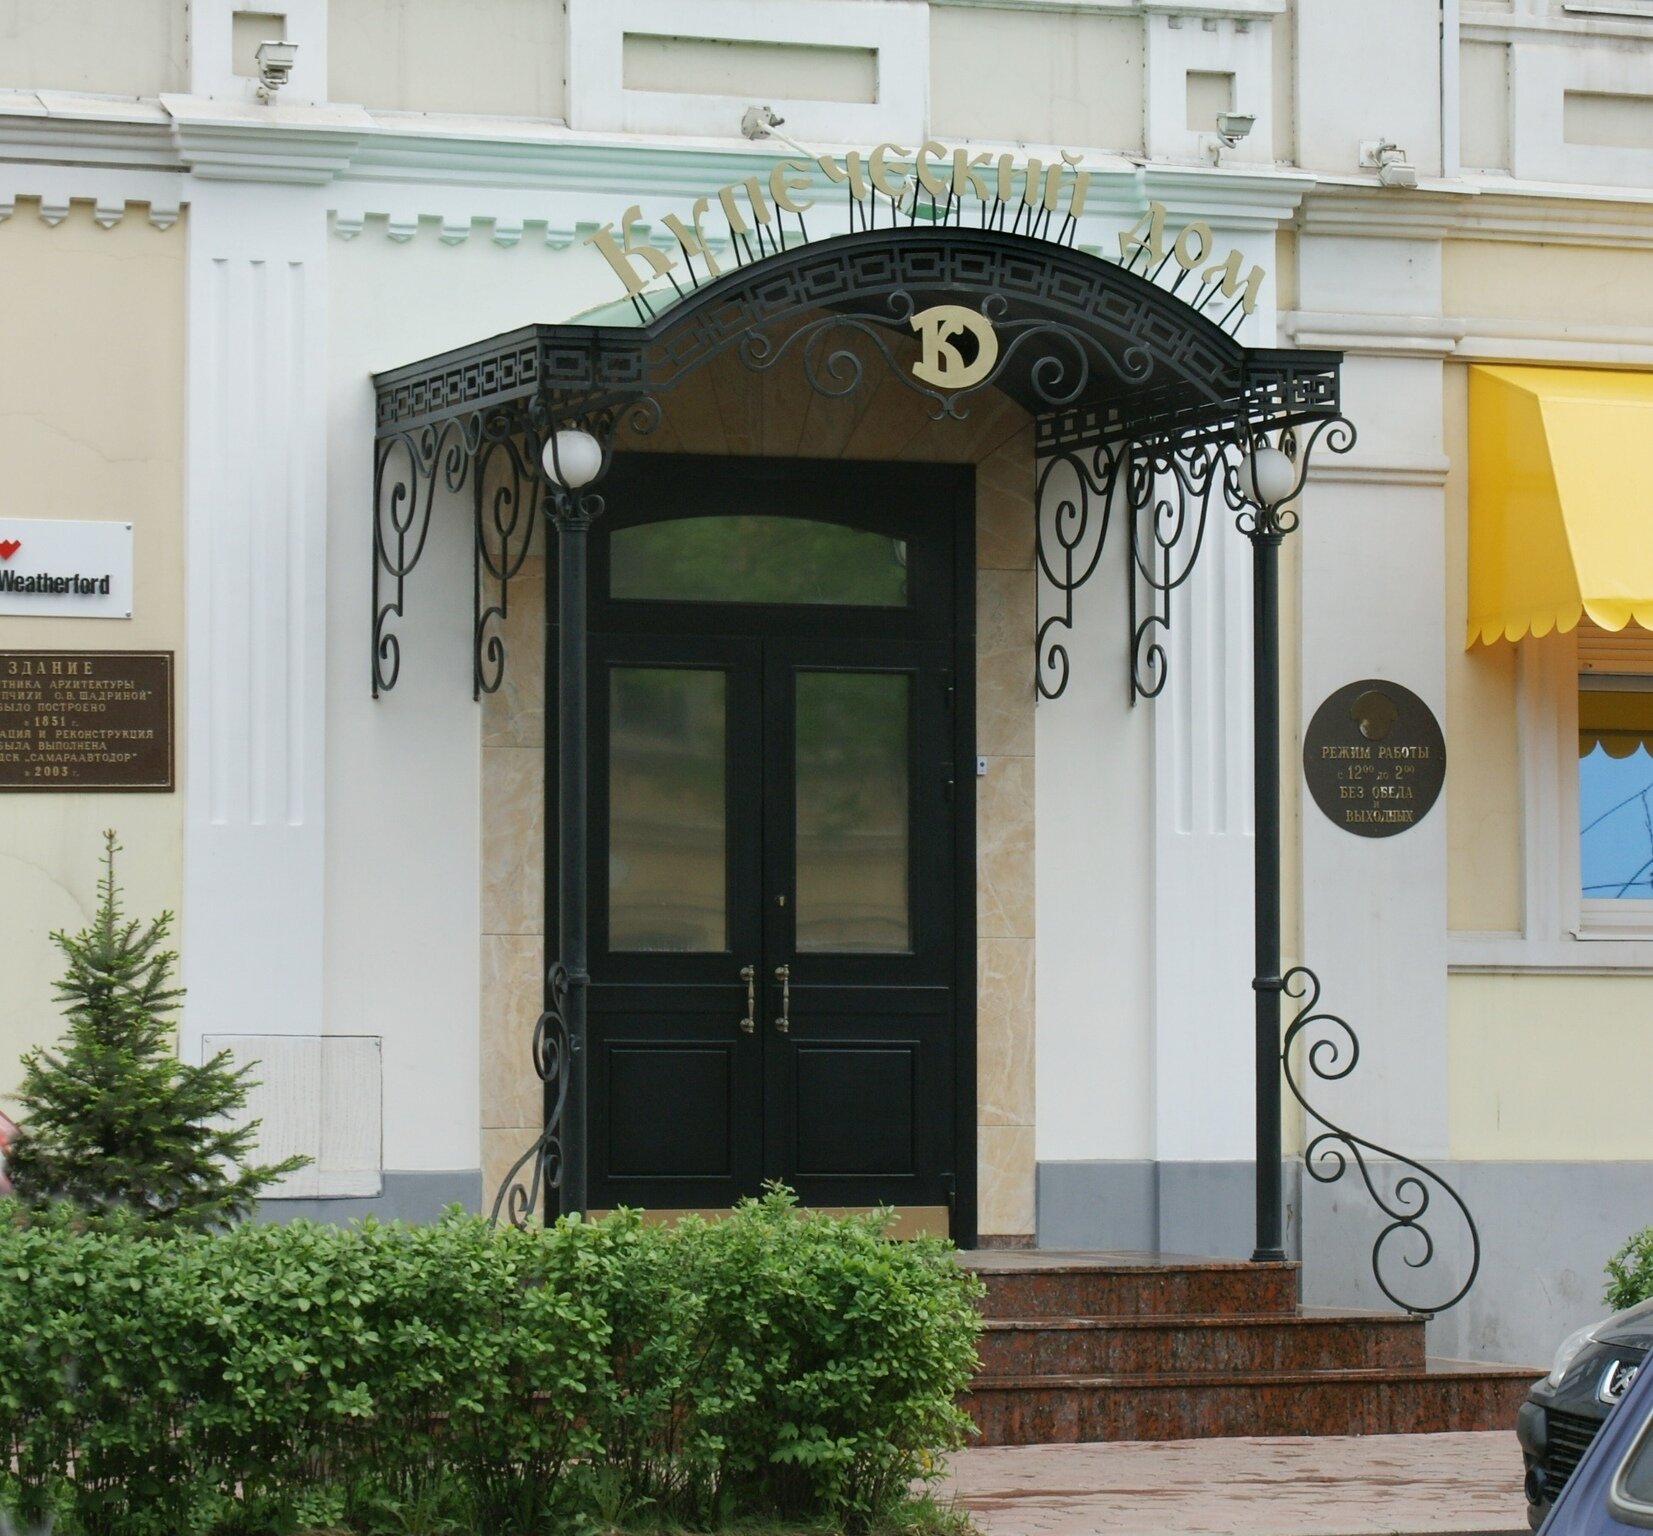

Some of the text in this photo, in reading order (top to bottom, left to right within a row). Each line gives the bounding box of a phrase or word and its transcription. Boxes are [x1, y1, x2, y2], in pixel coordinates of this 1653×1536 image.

[0, 570, 110, 595] Weatherford
[8, 661, 94, 675] ЗДАНИЕ
[50, 680, 135, 689] АРХИТЕКТУРЫ
[38, 703, 106, 712] ПОСТРОЕНО
[35, 715, 66, 727] 1851
[39, 730, 46, 739] И
[55, 730, 154, 740] РЕКОНСТРУКЦИЯ
[38, 742, 107, 751] ВЫПОЛНЕНА
[1321, 746, 1430, 759] РЕЖИМ РАБОТЫ
[1340, 786, 1414, 799] БЕЗ ОБЕДА
[1346, 810, 1413, 822] ВЫХОДНЫХ
